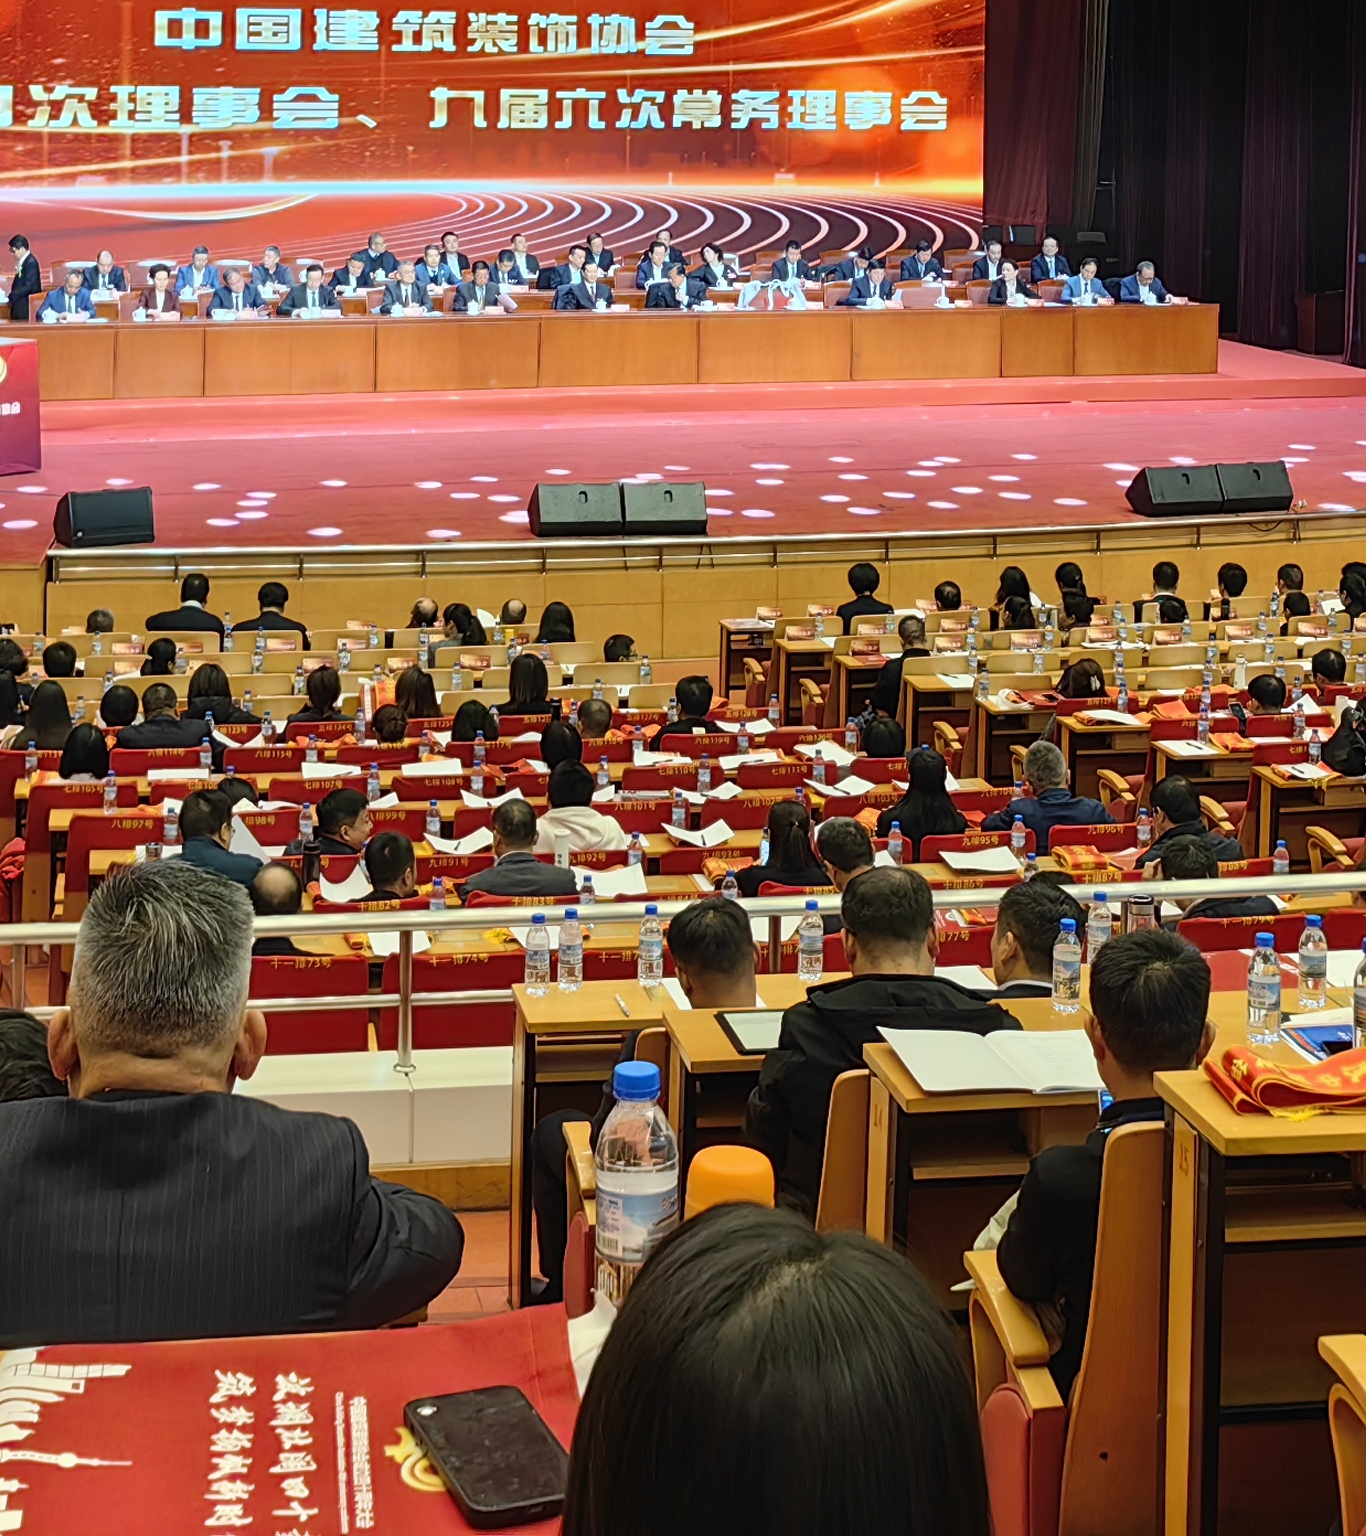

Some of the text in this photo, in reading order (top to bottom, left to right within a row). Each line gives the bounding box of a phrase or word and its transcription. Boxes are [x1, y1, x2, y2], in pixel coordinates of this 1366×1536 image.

[153, 5, 697, 58] 中国建筑装饰协会
[218, 725, 248, 735] 排123号
[188, 781, 219, 790] 七排106
[304, 779, 342, 790] 七排107号
[112, 819, 153, 830] 八排97号
[244, 816, 276, 826] 排98号
[962, 835, 999, 846] 九排95号
[429, 857, 469, 868] 九排91号
[1219, 861, 1248, 872] 排88号
[270, 957, 332, 969] 十一排73号
[429, 954, 489, 966] 十一排74号
